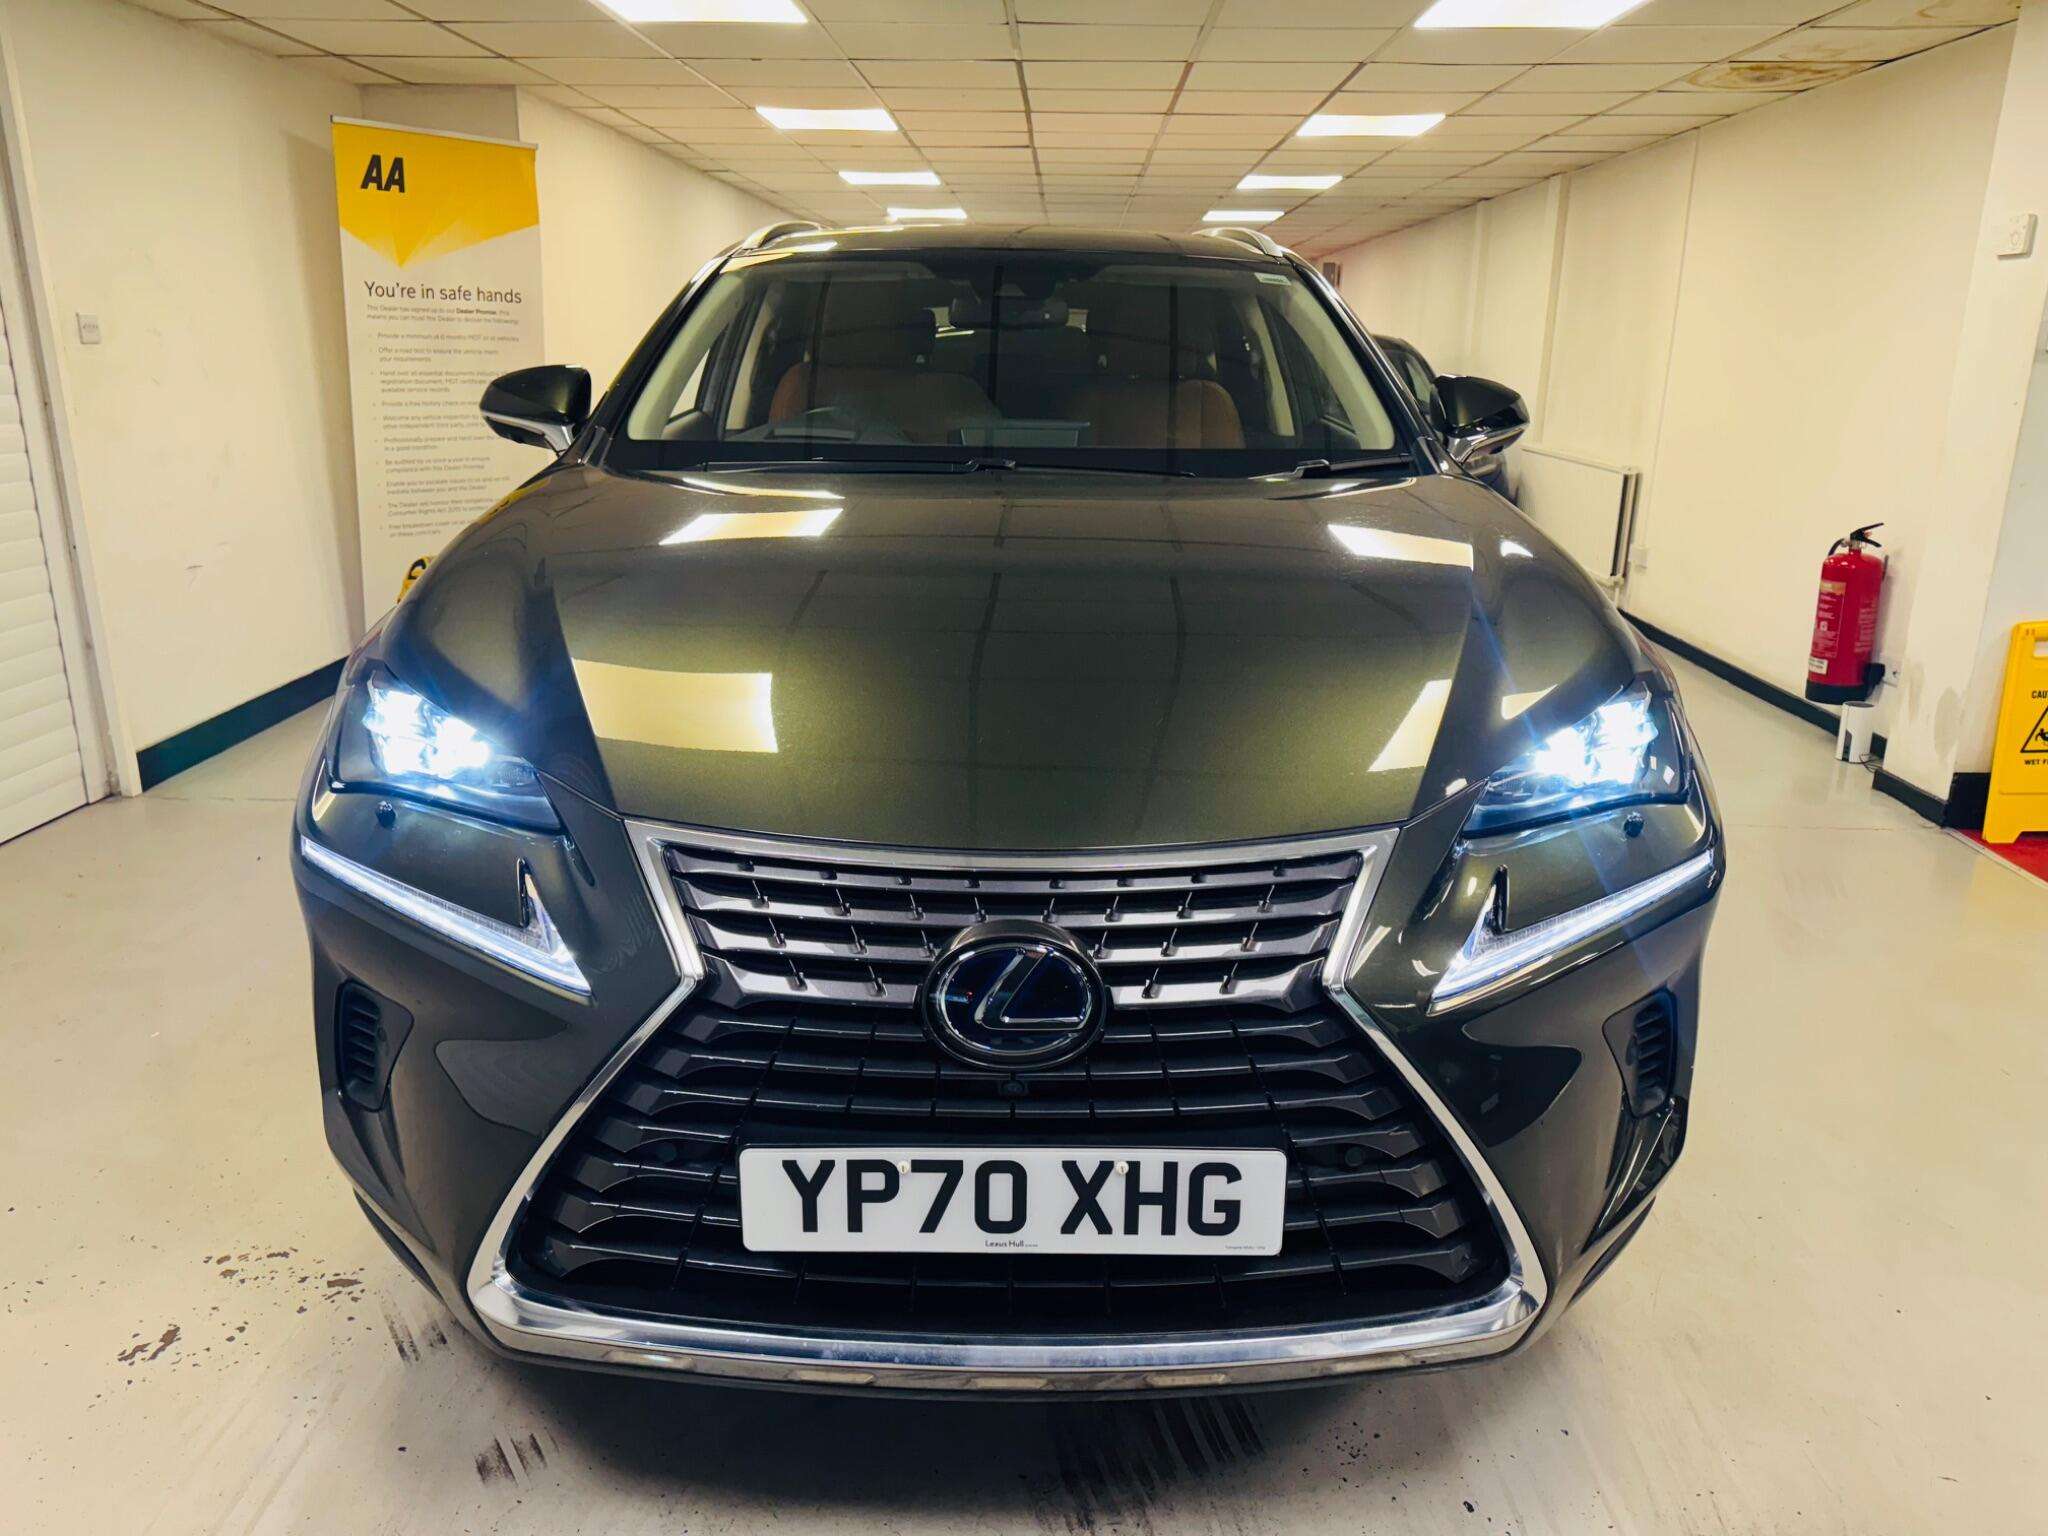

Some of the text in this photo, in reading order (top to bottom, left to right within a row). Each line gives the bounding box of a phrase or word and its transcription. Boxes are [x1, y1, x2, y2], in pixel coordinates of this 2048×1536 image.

[361, 154, 405, 193] AA
[364, 280, 522, 304] You're in safe hands
[2032, 690, 2048, 698] CAU
[781, 1159, 1243, 1237] YP70 XHG
[985, 1240, 1008, 1248] Lexus
[1008, 1240, 1024, 1248] Hull
